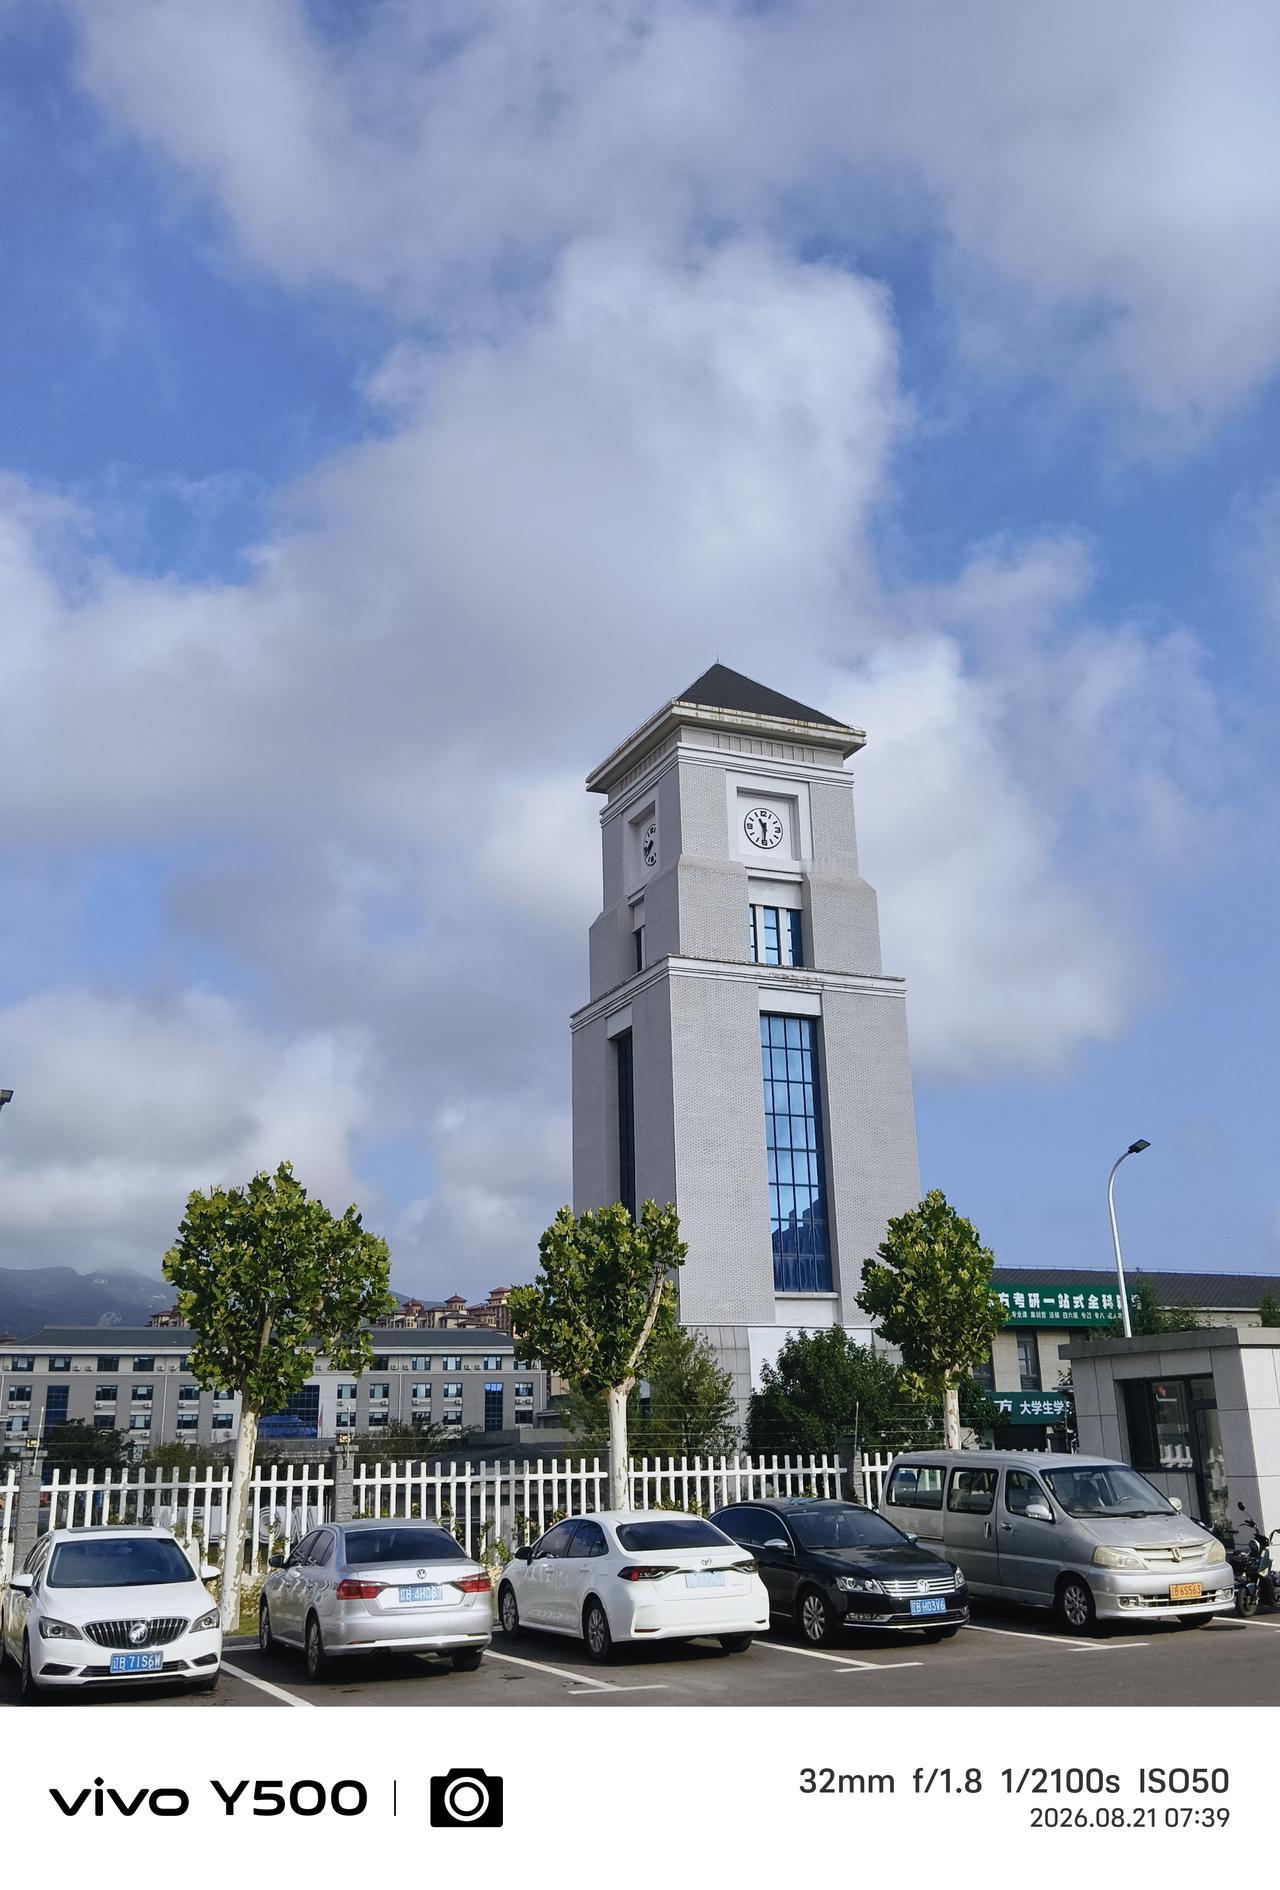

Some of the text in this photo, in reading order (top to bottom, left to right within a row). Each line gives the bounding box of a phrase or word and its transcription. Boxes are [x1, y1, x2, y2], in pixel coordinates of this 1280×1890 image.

[990, 1292, 1143, 1310] 方考研一站式全科
